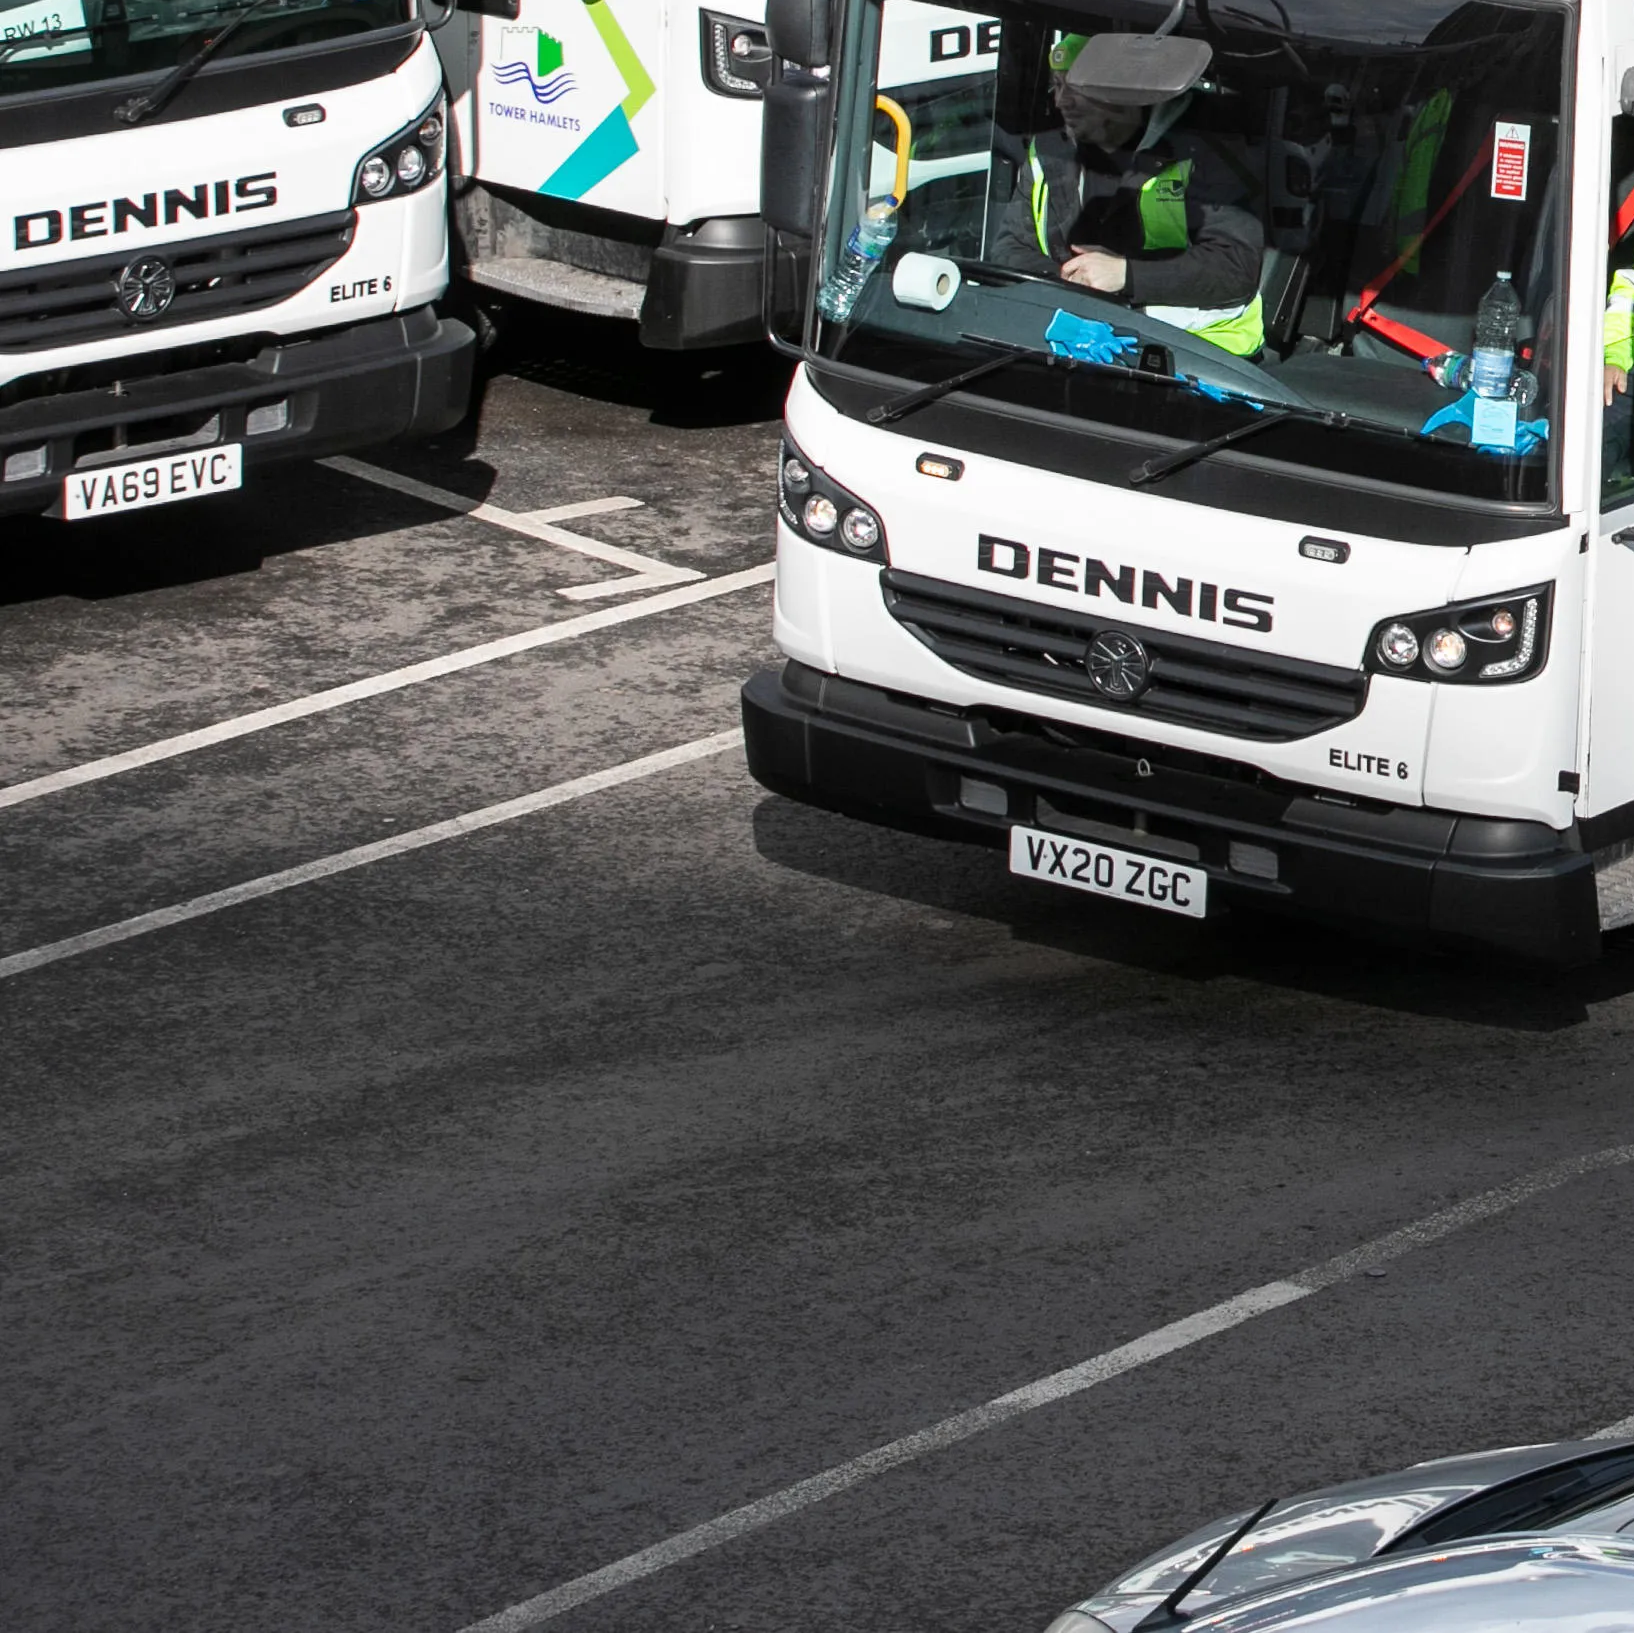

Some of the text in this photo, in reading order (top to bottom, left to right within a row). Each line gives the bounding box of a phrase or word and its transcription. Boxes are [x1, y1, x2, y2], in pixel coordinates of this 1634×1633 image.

[40, 13, 63, 33] 13
[489, 102, 581, 132] TOWER HAMLETS
[14, 171, 278, 251] DENNIS
[330, 276, 392, 303] ELITE 6
[81, 453, 227, 510] VA69 EVC
[977, 533, 1275, 633] DENNIS
[1328, 748, 1409, 779] ELITE 6
[1026, 834, 1191, 907] VX20 ZGC
